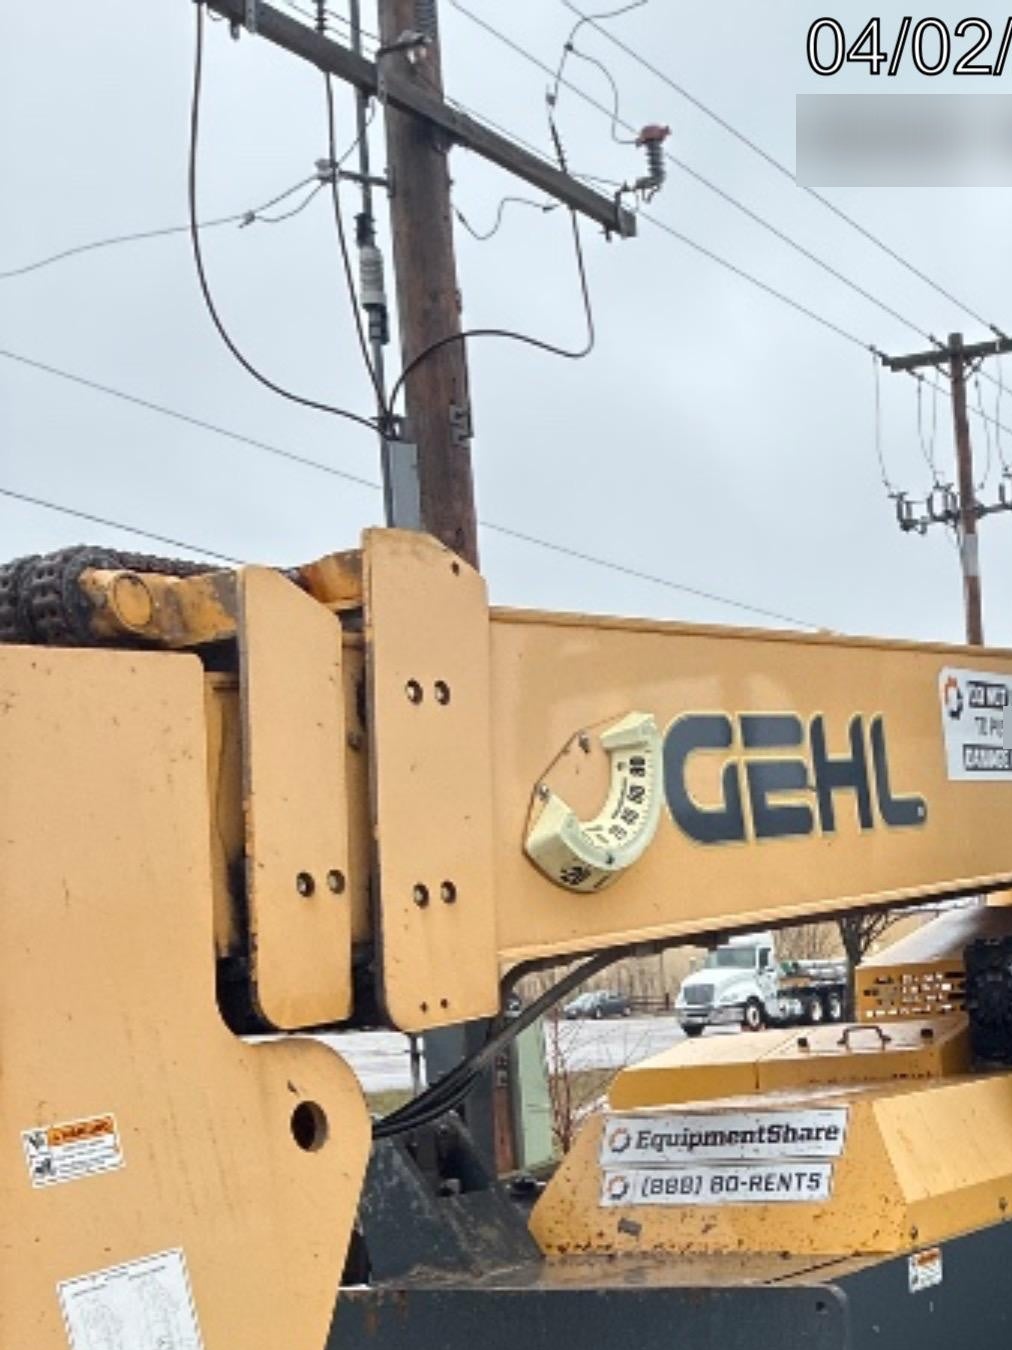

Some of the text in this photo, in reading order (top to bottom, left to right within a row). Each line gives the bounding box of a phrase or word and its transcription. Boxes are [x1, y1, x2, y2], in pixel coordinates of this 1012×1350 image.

[663, 713, 928, 842] GEHL
[635, 1123, 840, 1152] EquipmentShare
[641, 1175, 703, 1197] (888)
